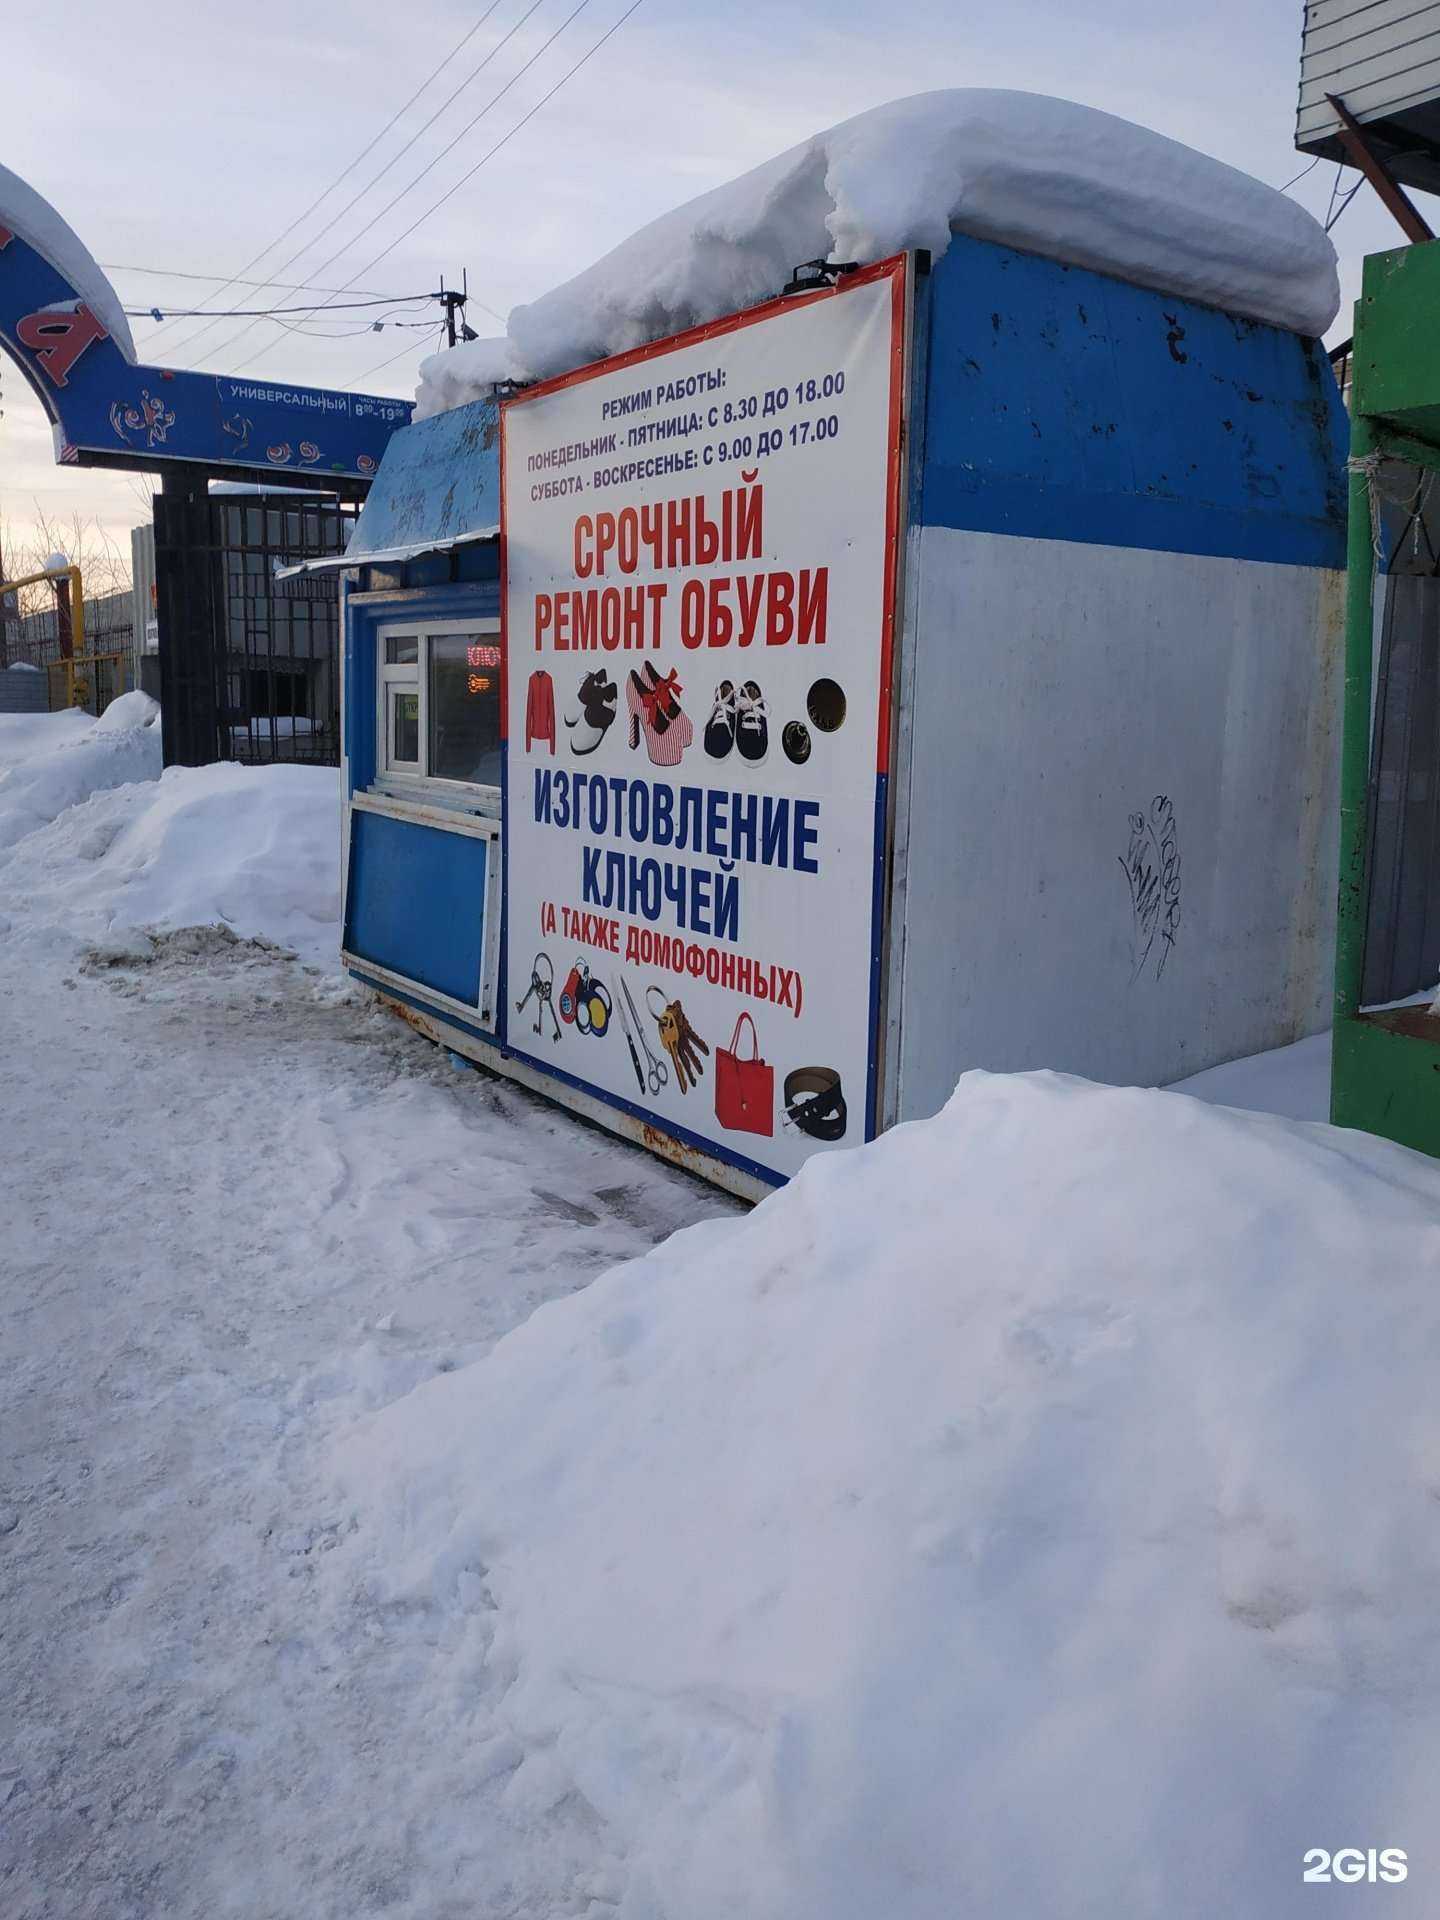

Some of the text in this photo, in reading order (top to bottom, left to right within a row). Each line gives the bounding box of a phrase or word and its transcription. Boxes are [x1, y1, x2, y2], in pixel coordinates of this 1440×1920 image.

[230, 384, 347, 411] УНИВЕРСАЛЬНЫЙ
[527, 434, 617, 472] ПОНЕДЕЛЬНИК
[627, 411, 703, 447] ПЯТНИЦА:
[707, 406, 719, 428] С
[723, 396, 758, 424] 8.30
[762, 387, 789, 418] ДО
[795, 371, 846, 404] 18.00
[602, 368, 727, 421] РЕЖИМ РАБОТЫ:
[530, 475, 584, 501] СУББОТА
[593, 449, 699, 488] ВОСКРЕСЕНЬЕ:
[702, 445, 714, 466] С
[718, 436, 752, 462] 9.00
[756, 429, 783, 458] ДО
[789, 415, 839, 447] 17.00
[573, 467, 764, 579] СРОЧНЫЙ
[534, 566, 830, 651] РЕМОНТ ОБУВИ
[533, 767, 821, 874] ИЗГОТОВЛЕНИЕ
[582, 845, 740, 942] КЛЮЧЕЙ
[540, 901, 804, 1018] (А ТАКЖЕ ДОМОФОННЫХ)
